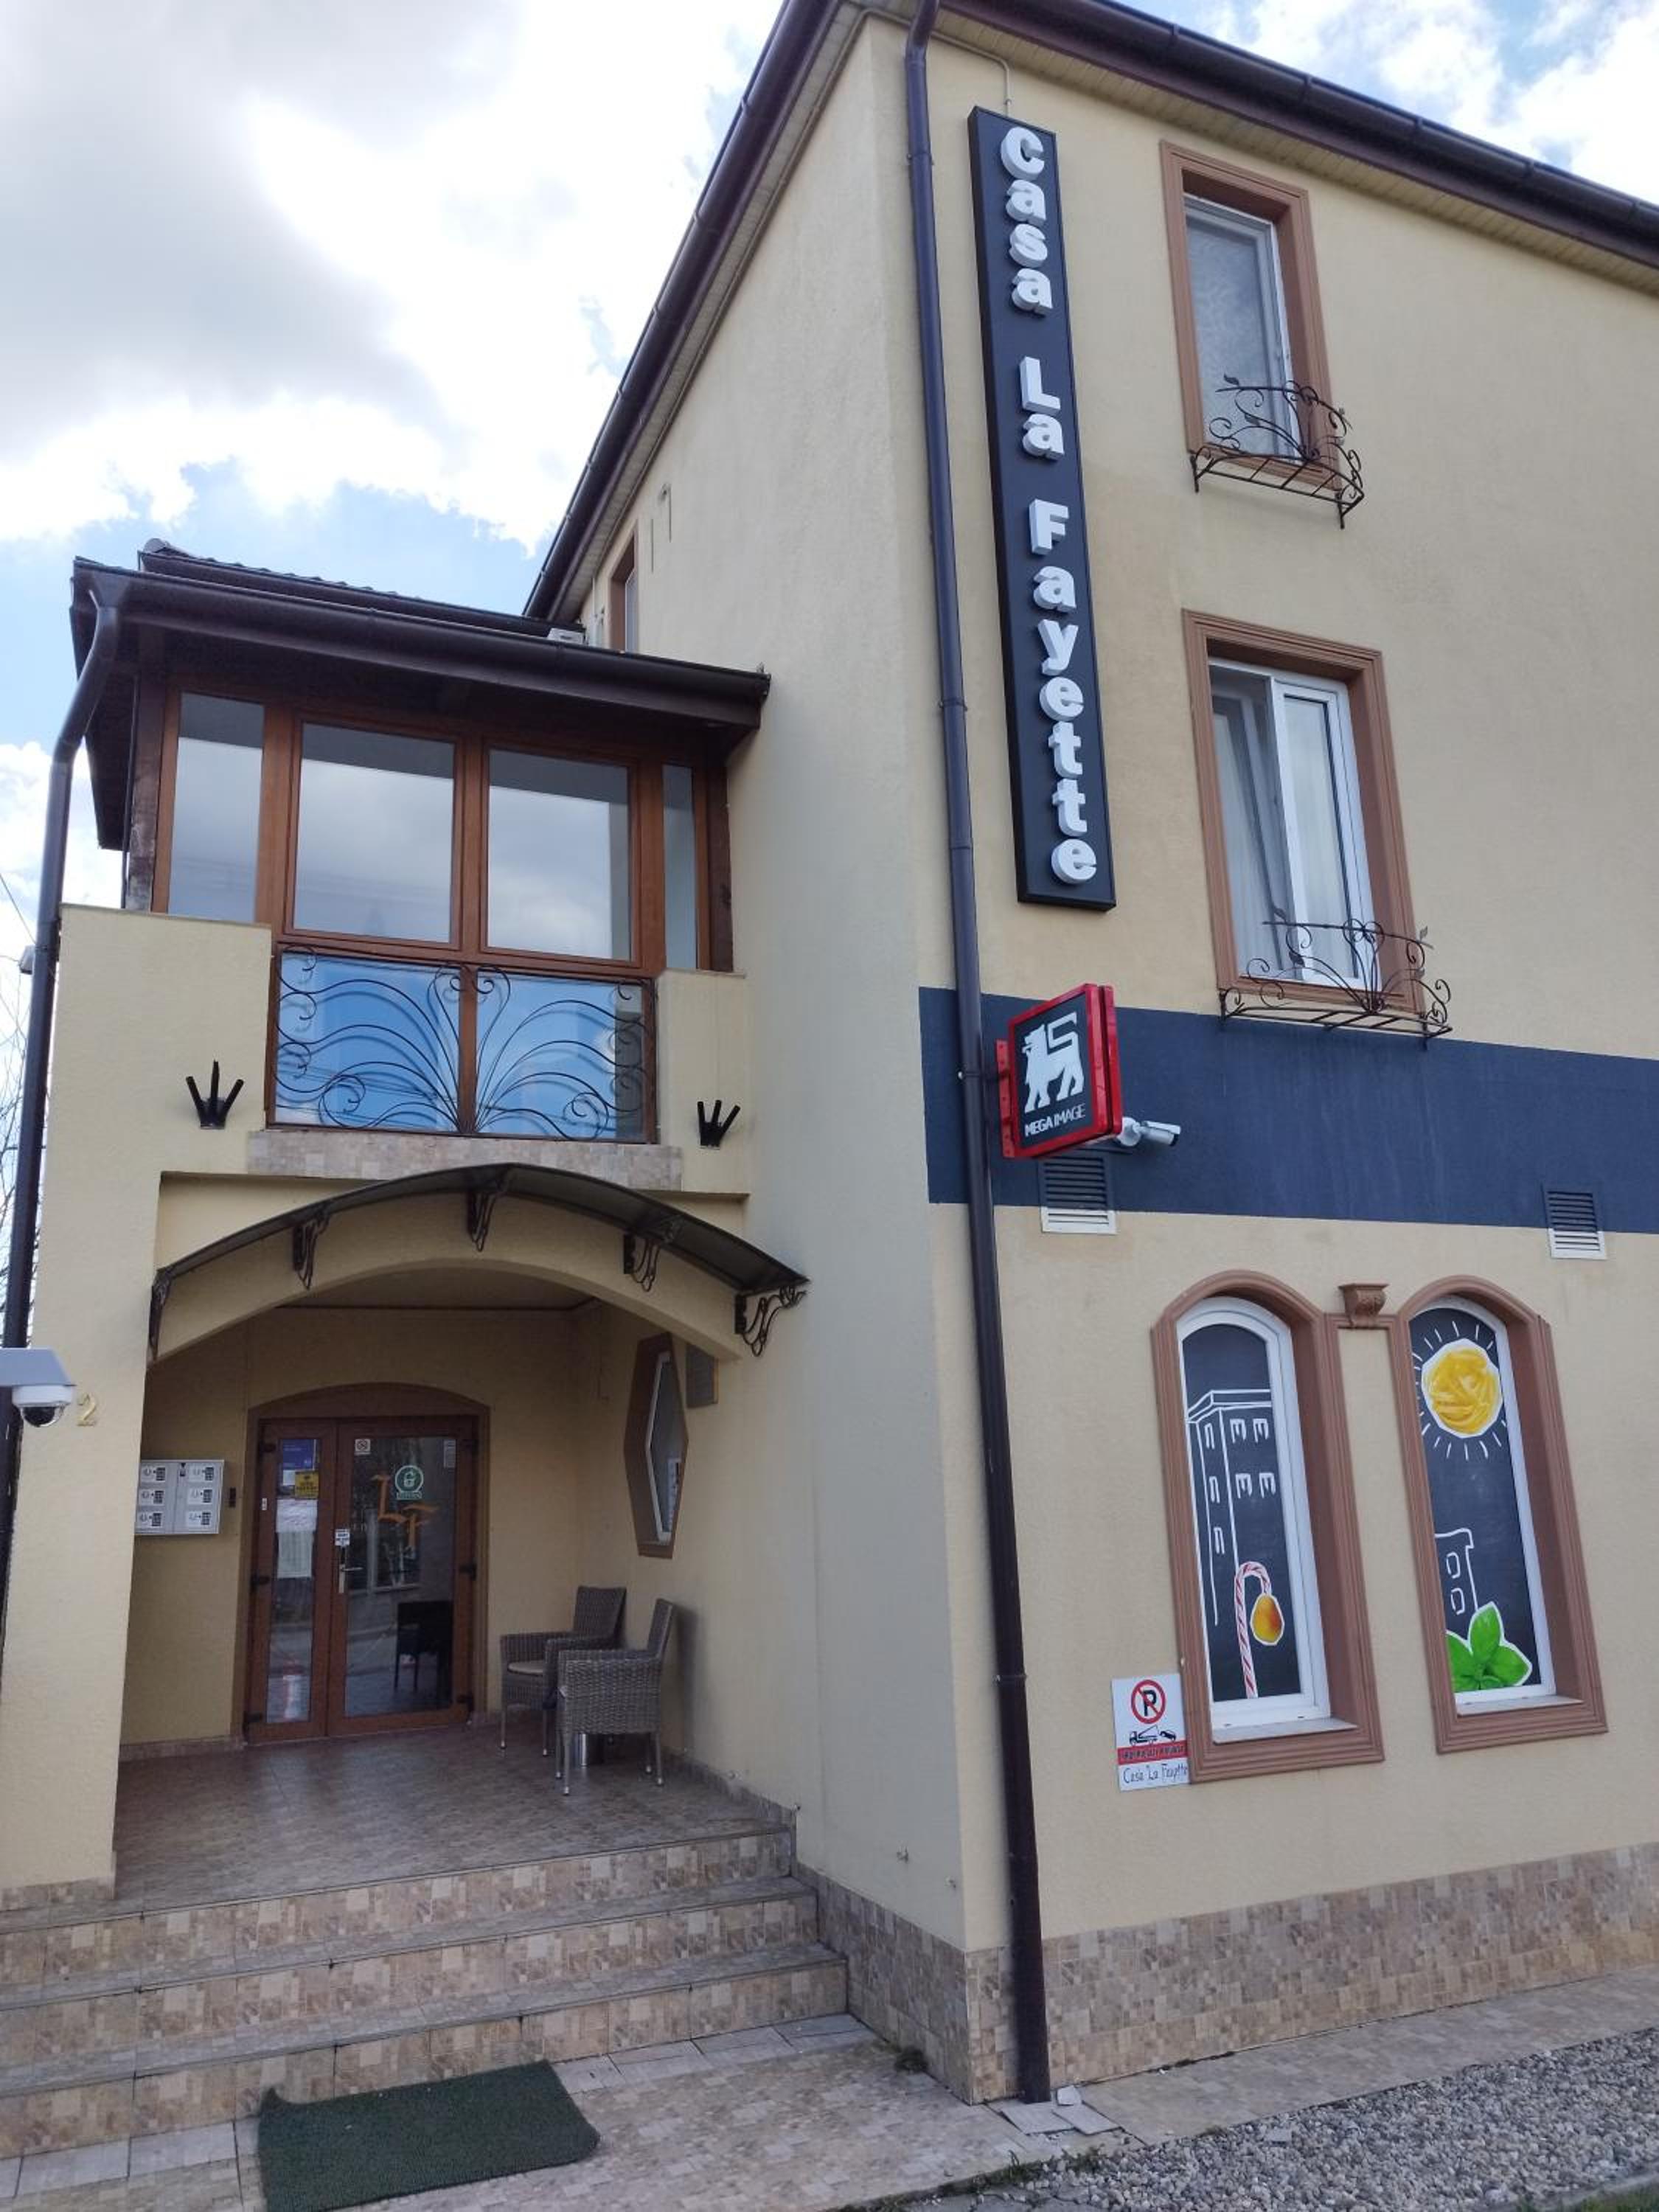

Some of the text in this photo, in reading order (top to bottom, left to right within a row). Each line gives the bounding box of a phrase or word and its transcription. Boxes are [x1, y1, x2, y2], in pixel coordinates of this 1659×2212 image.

[1001, 126, 1096, 884] Casa La Fayette
[1024, 1103, 1085, 1137] MEGA IMAGE
[77, 1393, 97, 1427] 2
[1142, 1689, 1157, 1717] P
